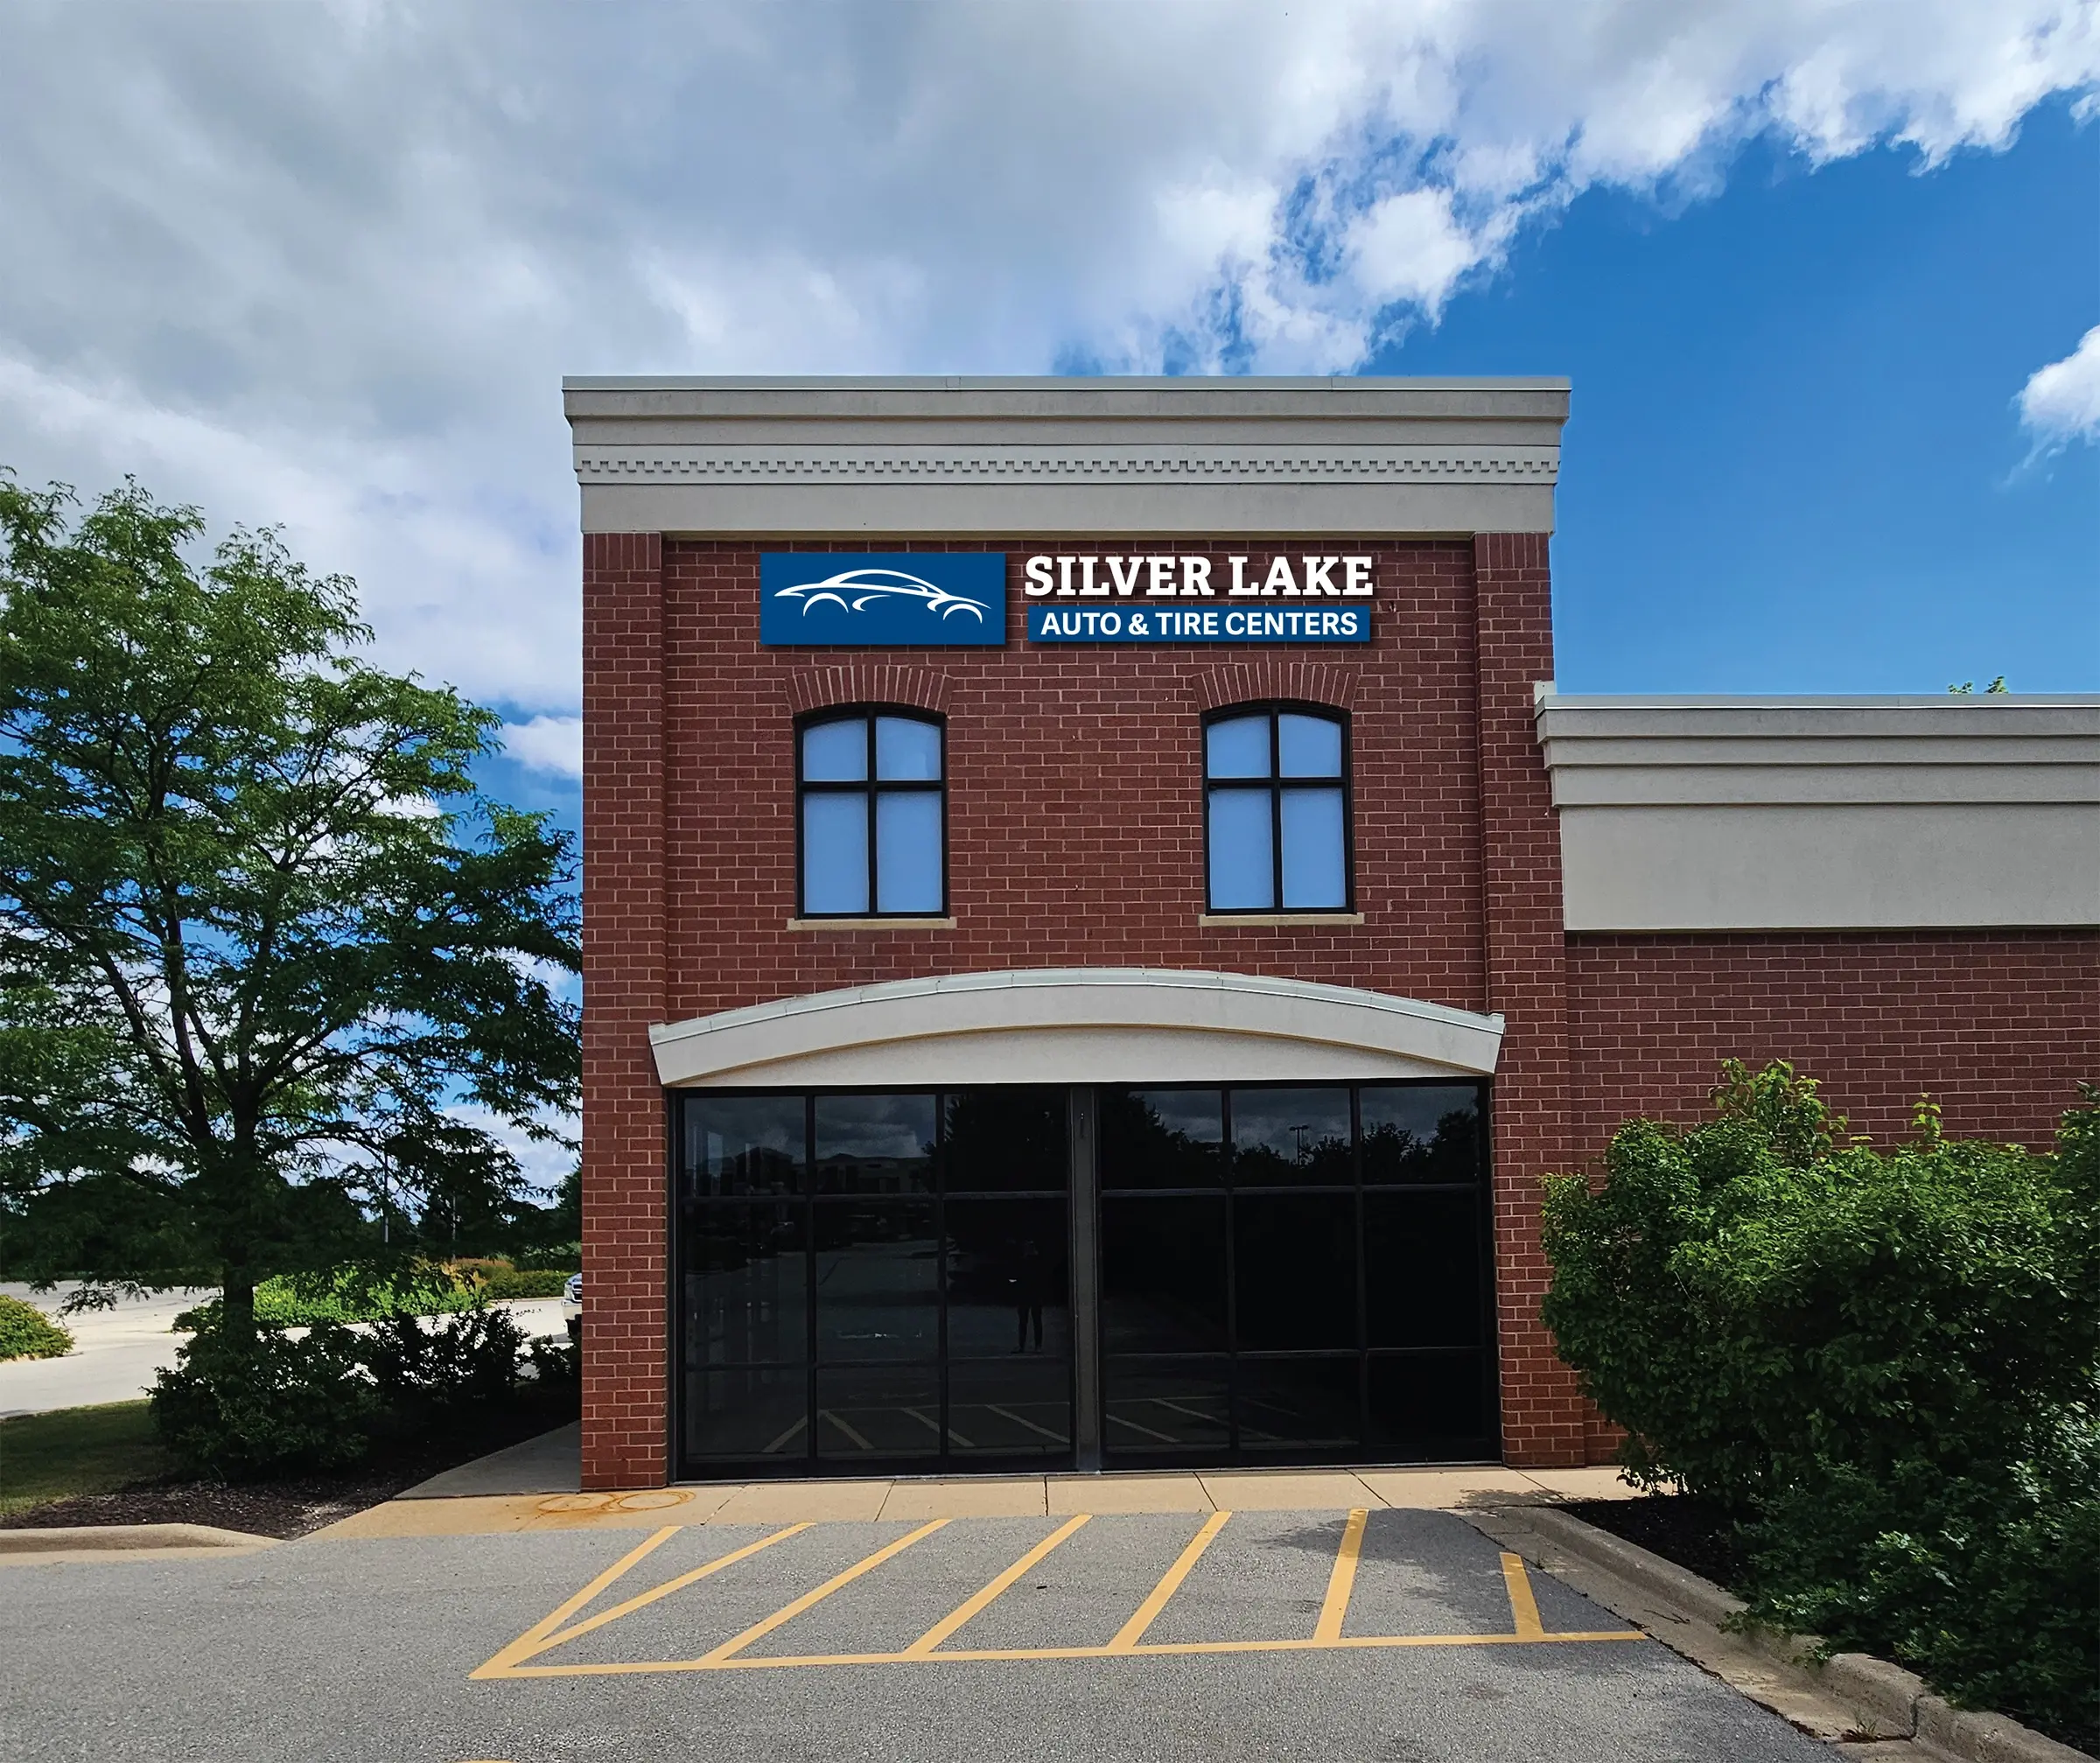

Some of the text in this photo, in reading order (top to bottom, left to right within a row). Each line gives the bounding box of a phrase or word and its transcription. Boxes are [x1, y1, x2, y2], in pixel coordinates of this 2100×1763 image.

[1025, 556, 1373, 596] SILVER LAKE
[1040, 612, 1358, 635] AUTO & TIRE CENTERS
